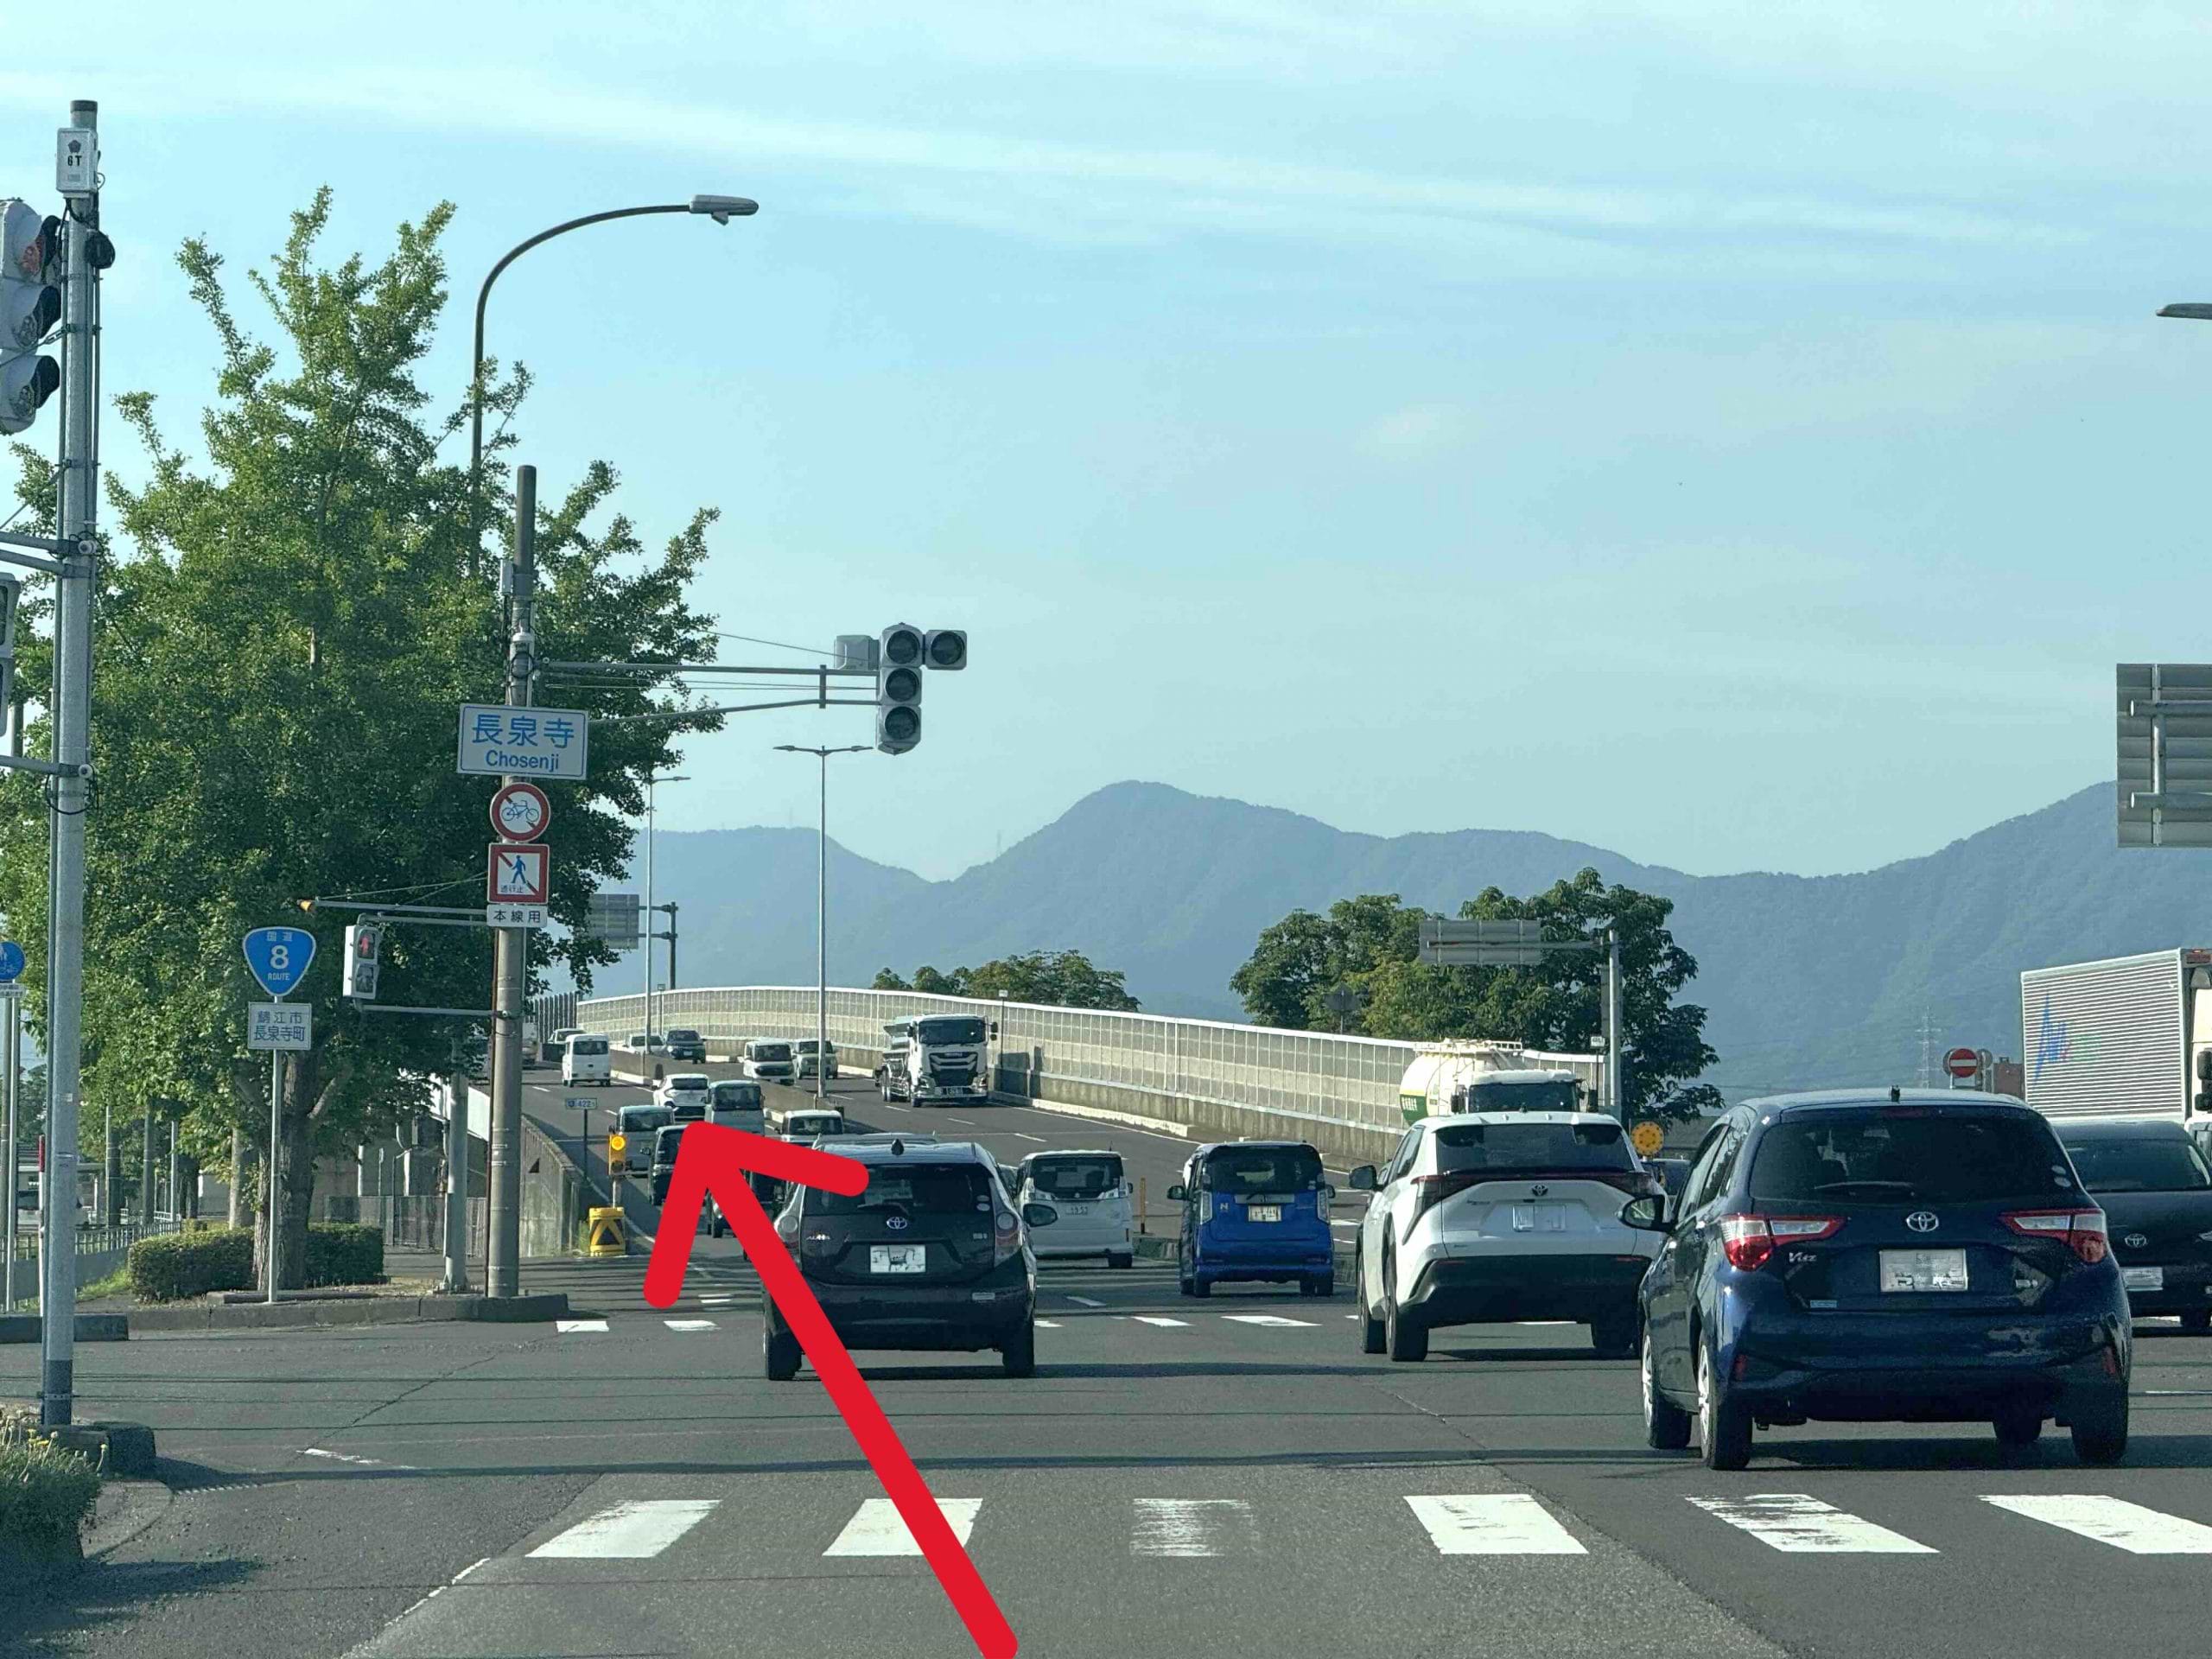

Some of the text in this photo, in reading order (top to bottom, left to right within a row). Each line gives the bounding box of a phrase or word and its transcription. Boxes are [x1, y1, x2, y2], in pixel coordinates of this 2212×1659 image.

[472, 714, 575, 749] 長泉寺
[486, 749, 559, 772] Chosenji
[493, 909, 541, 924] 本線用
[267, 931, 293, 942] 国道
[270, 944, 289, 969] 8
[267, 972, 290, 981] ROUTE
[254, 1025, 305, 1042] 長泉寺町
[1789, 1251, 1817, 1262] Vitz
